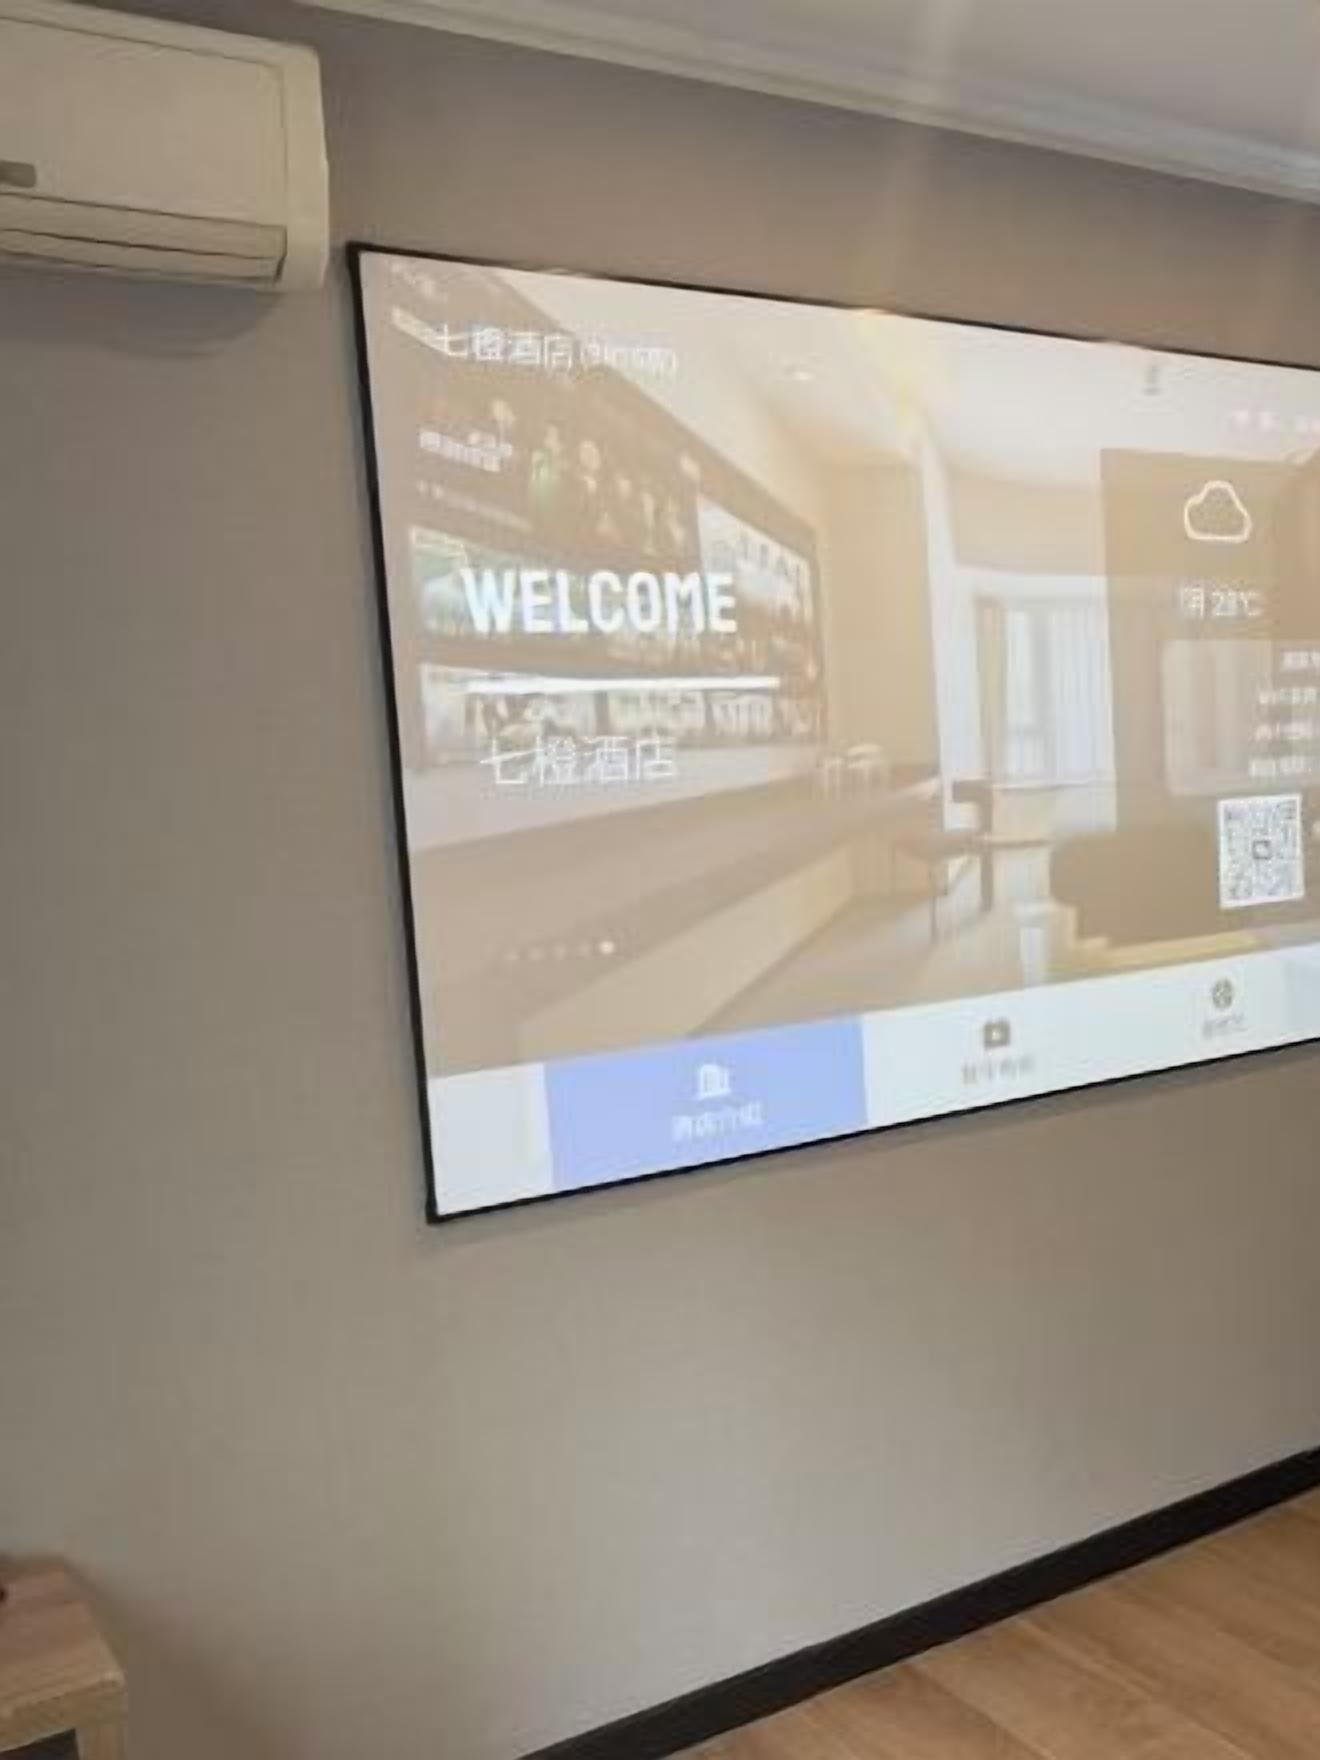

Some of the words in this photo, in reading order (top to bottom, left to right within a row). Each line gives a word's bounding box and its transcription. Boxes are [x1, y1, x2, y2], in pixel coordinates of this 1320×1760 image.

[460, 566, 738, 637] WELCOME
[479, 735, 676, 788] 七橙酒店
